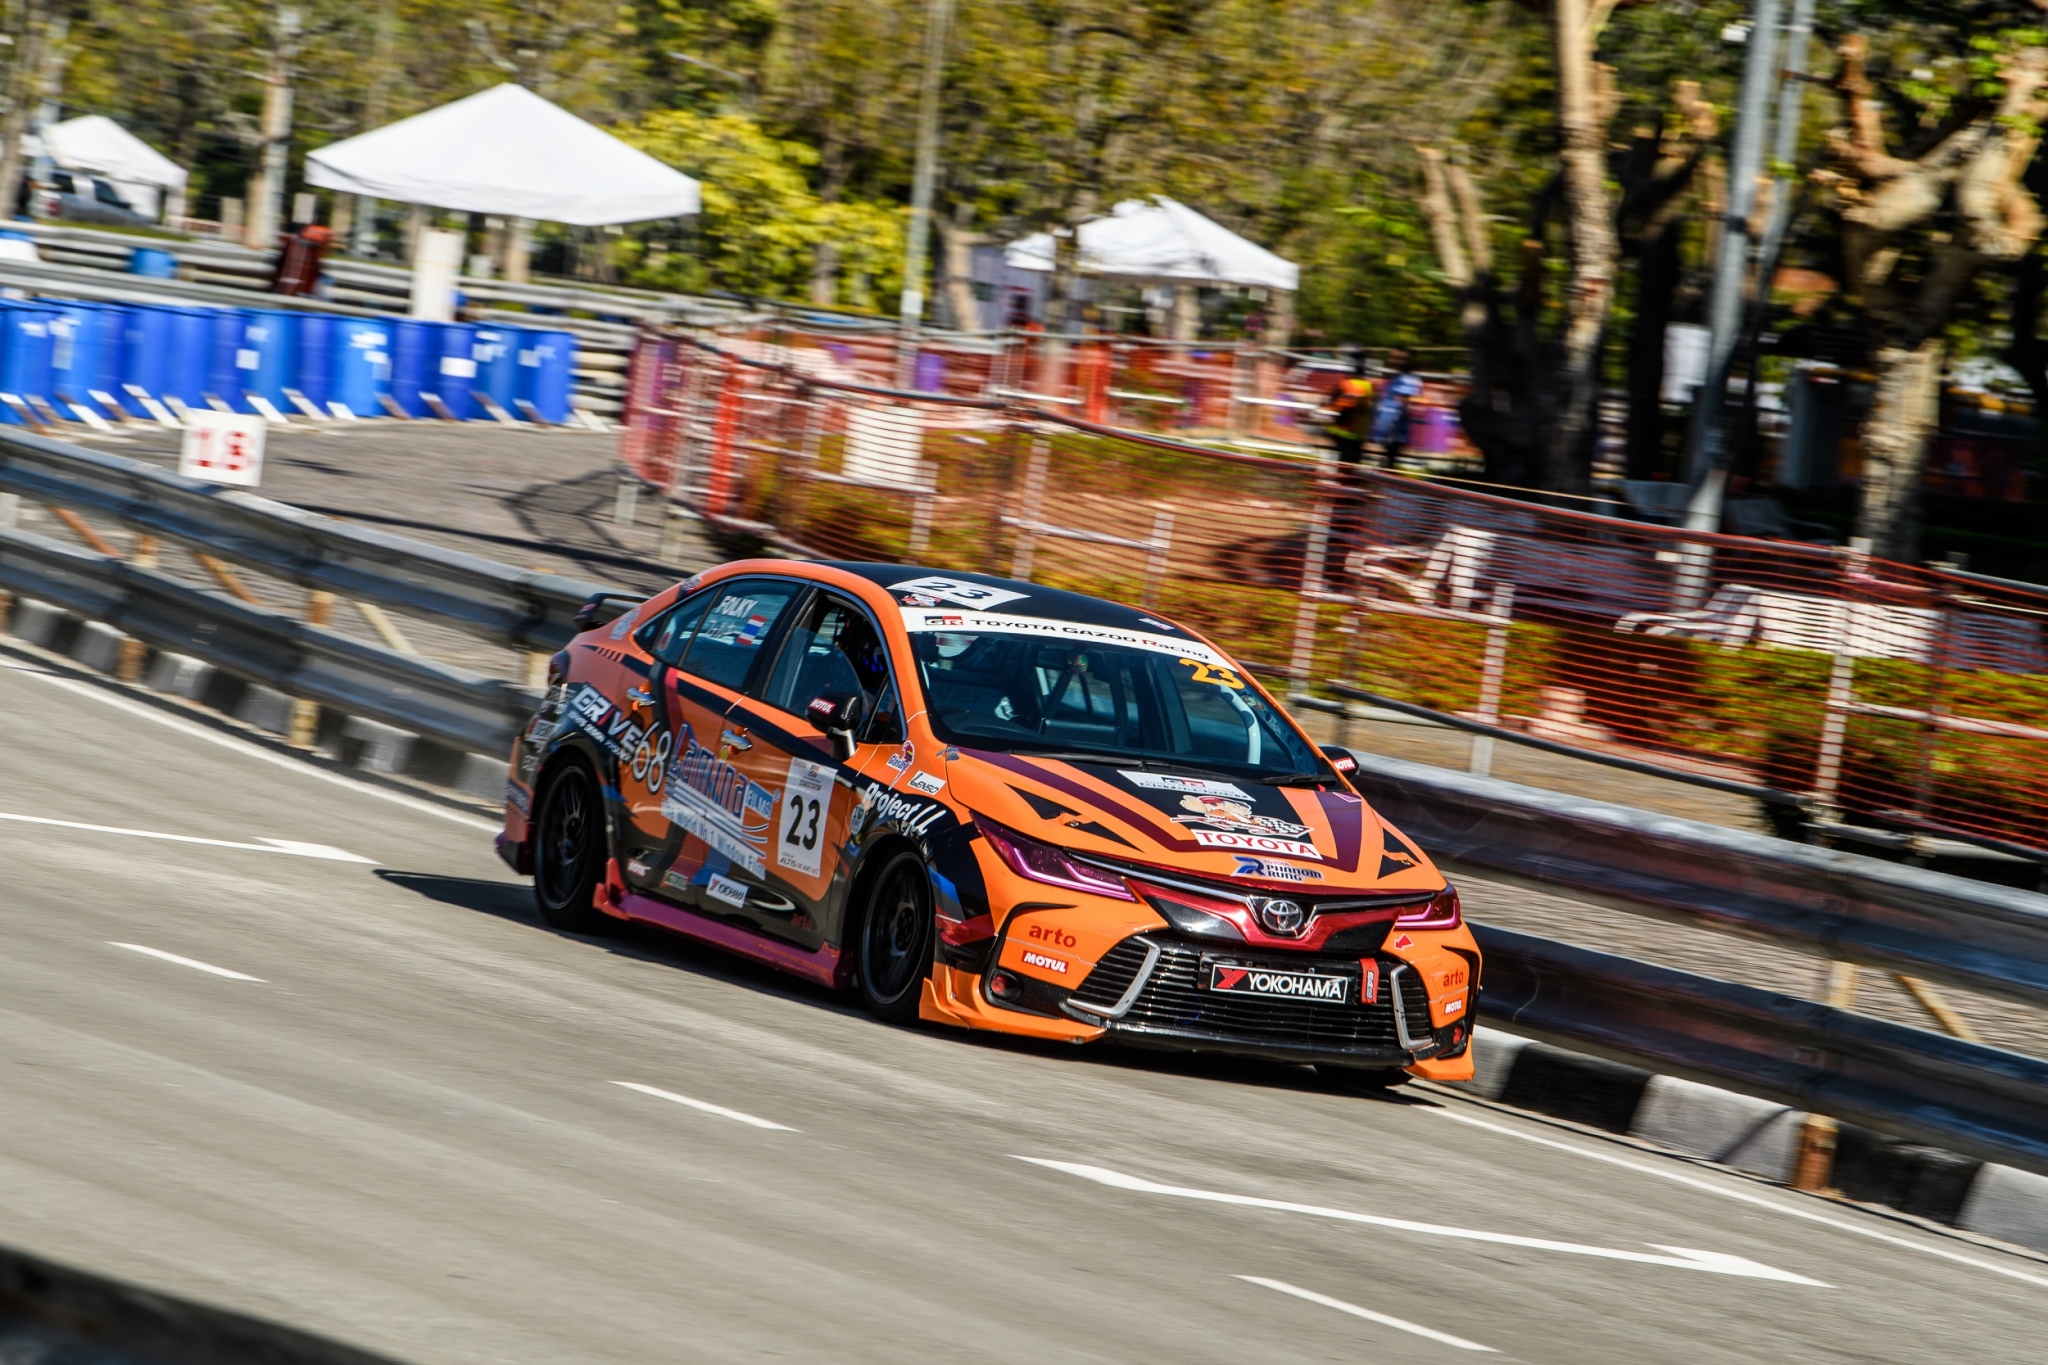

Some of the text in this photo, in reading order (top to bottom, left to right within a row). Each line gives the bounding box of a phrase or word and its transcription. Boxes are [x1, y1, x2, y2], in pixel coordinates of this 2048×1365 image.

[913, 581, 994, 600] 23
[715, 595, 759, 618] FOLKY
[924, 616, 1209, 660] GR TOYOTA GAZOO Racing
[1178, 658, 1246, 690] 23
[809, 698, 836, 714] MOTUL
[632, 721, 672, 793] 68
[667, 722, 749, 820] Lamina
[746, 787, 772, 819] FILMS
[785, 793, 821, 851] 23
[1196, 831, 1318, 856] TOYOTA
[791, 913, 814, 932] arto
[1028, 925, 1077, 948] arto
[1023, 952, 1067, 973] MOTUL
[1248, 972, 1342, 999] YOKOHAMA
[1443, 969, 1464, 987] arto
[1444, 1000, 1463, 1015] MOTUL
